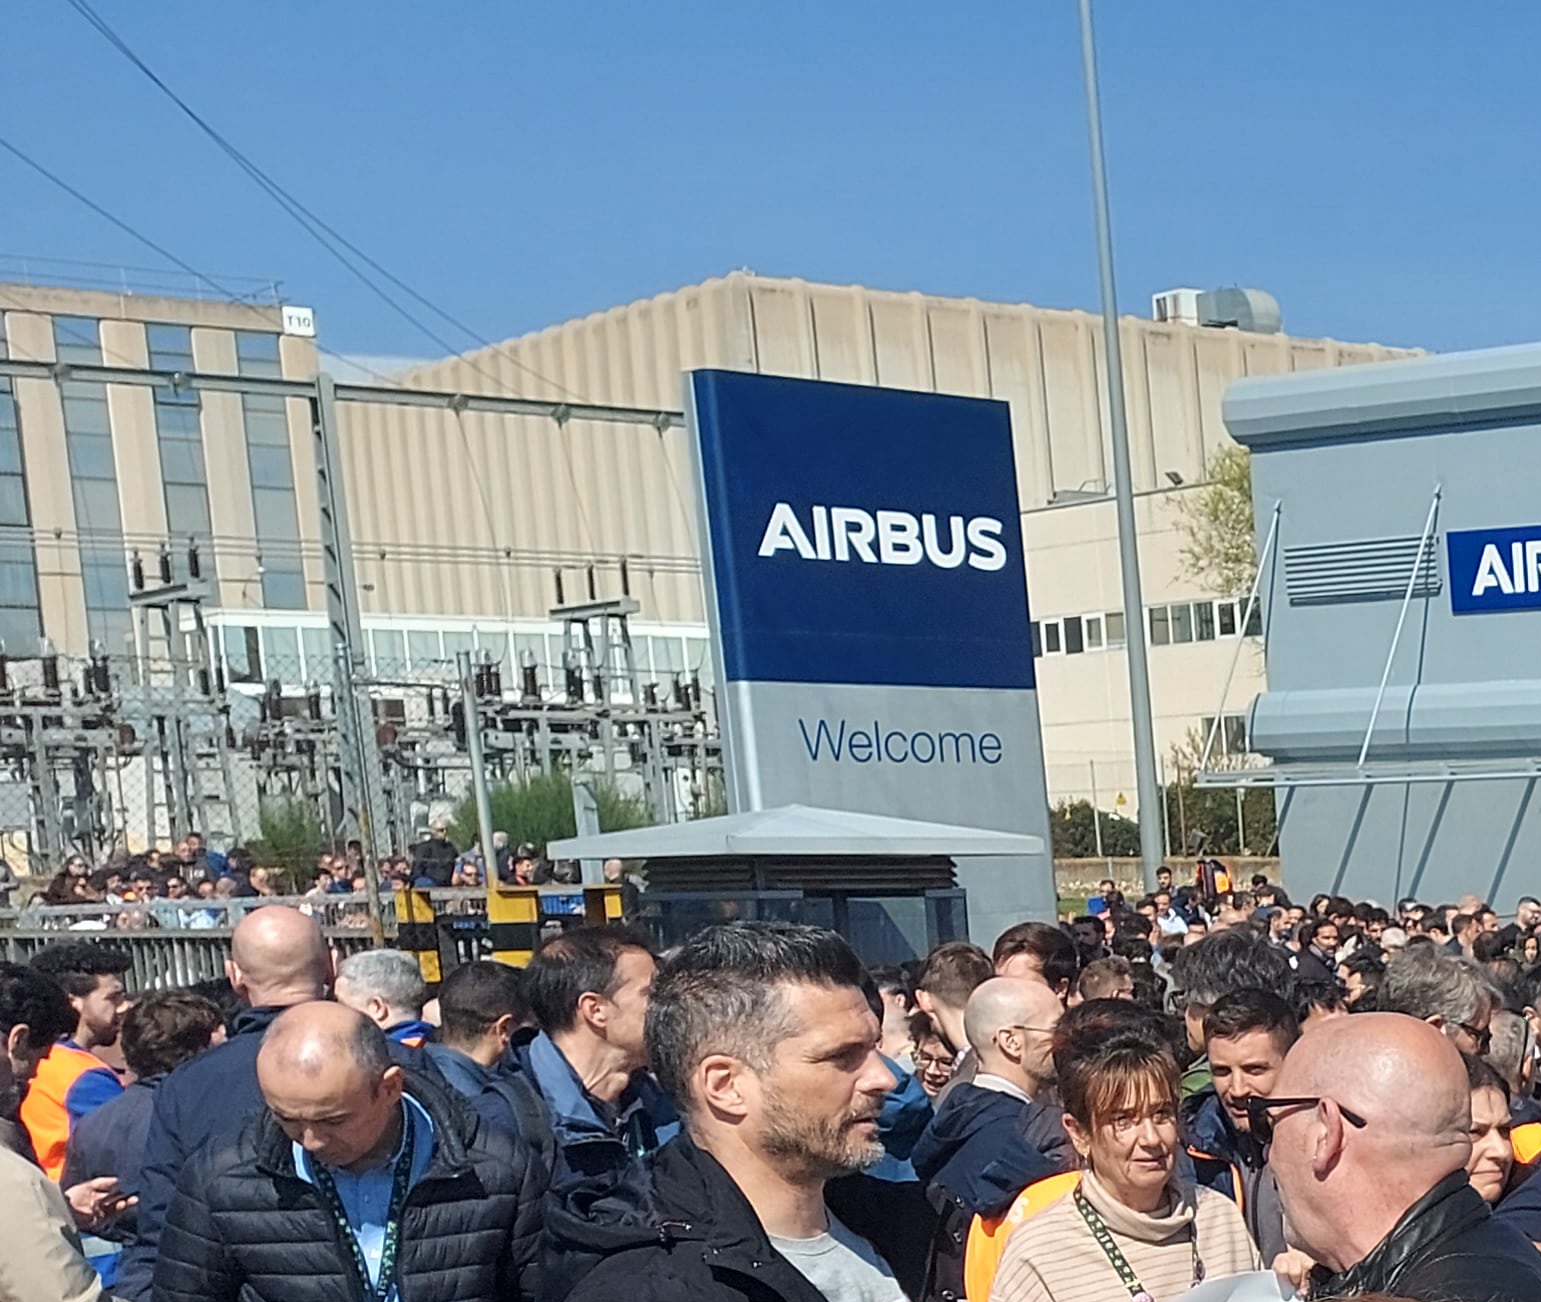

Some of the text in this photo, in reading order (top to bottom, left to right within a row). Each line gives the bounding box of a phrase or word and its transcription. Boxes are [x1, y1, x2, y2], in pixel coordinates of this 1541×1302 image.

[287, 315, 311, 328] T10
[758, 502, 1007, 571] AIRBUS
[799, 719, 1002, 764] Welcome
